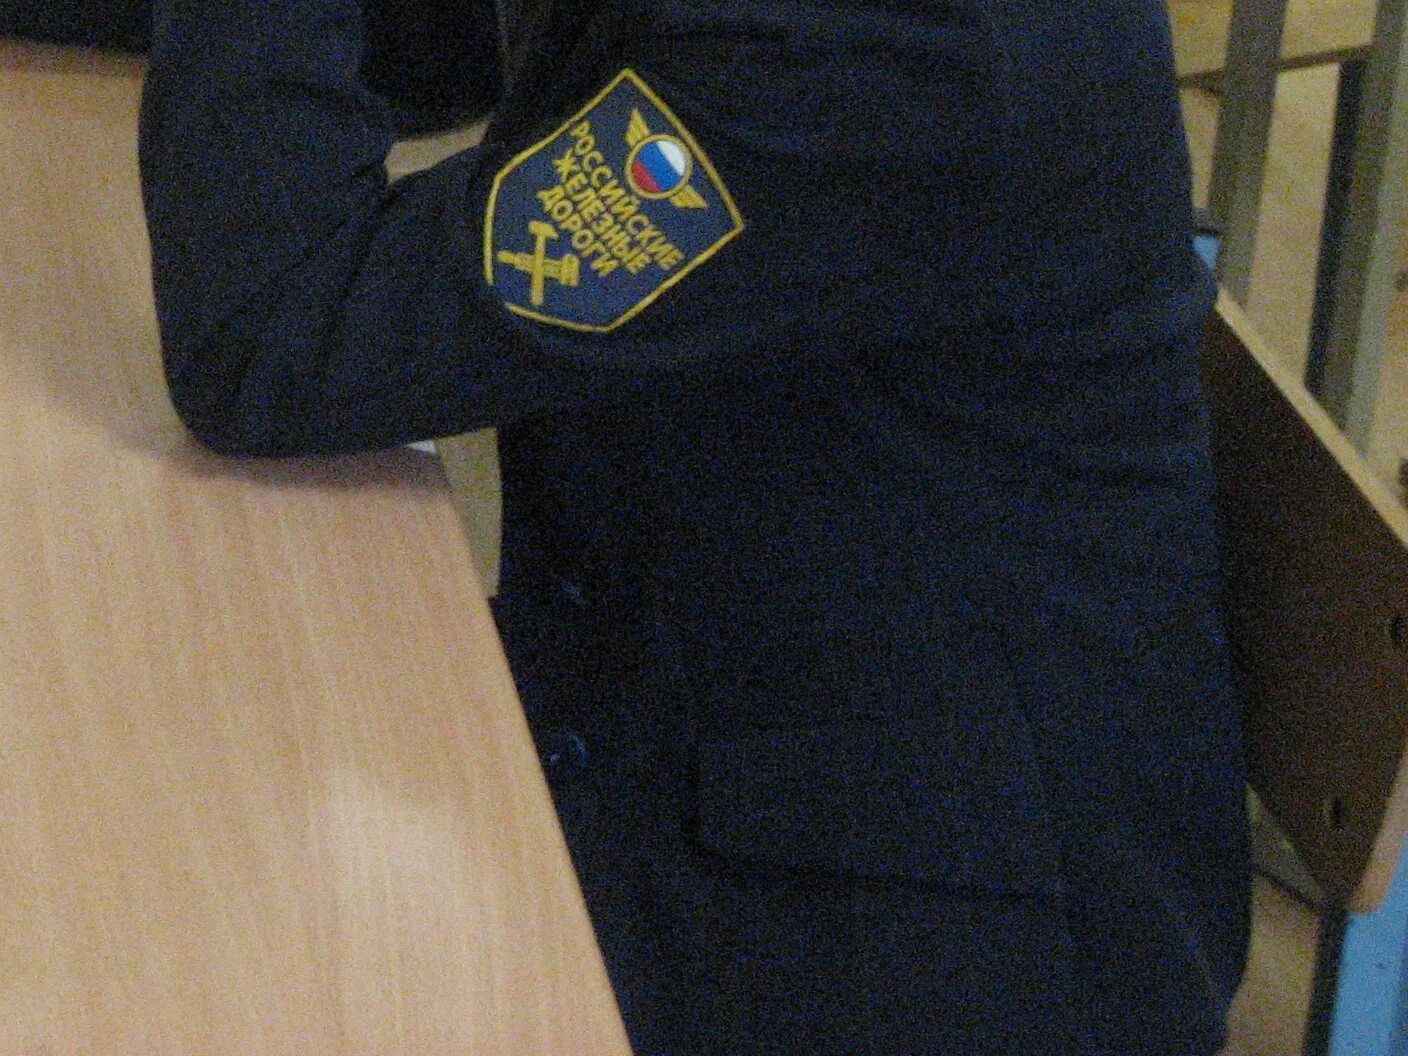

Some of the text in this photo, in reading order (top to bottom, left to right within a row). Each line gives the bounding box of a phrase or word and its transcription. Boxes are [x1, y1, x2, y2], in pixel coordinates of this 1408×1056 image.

[536, 187, 620, 277] ДОРОГИ
[553, 147, 652, 275] ЖЕЛЕЗНЫЕ
[570, 120, 685, 271] РОССИЙСКИЕ
